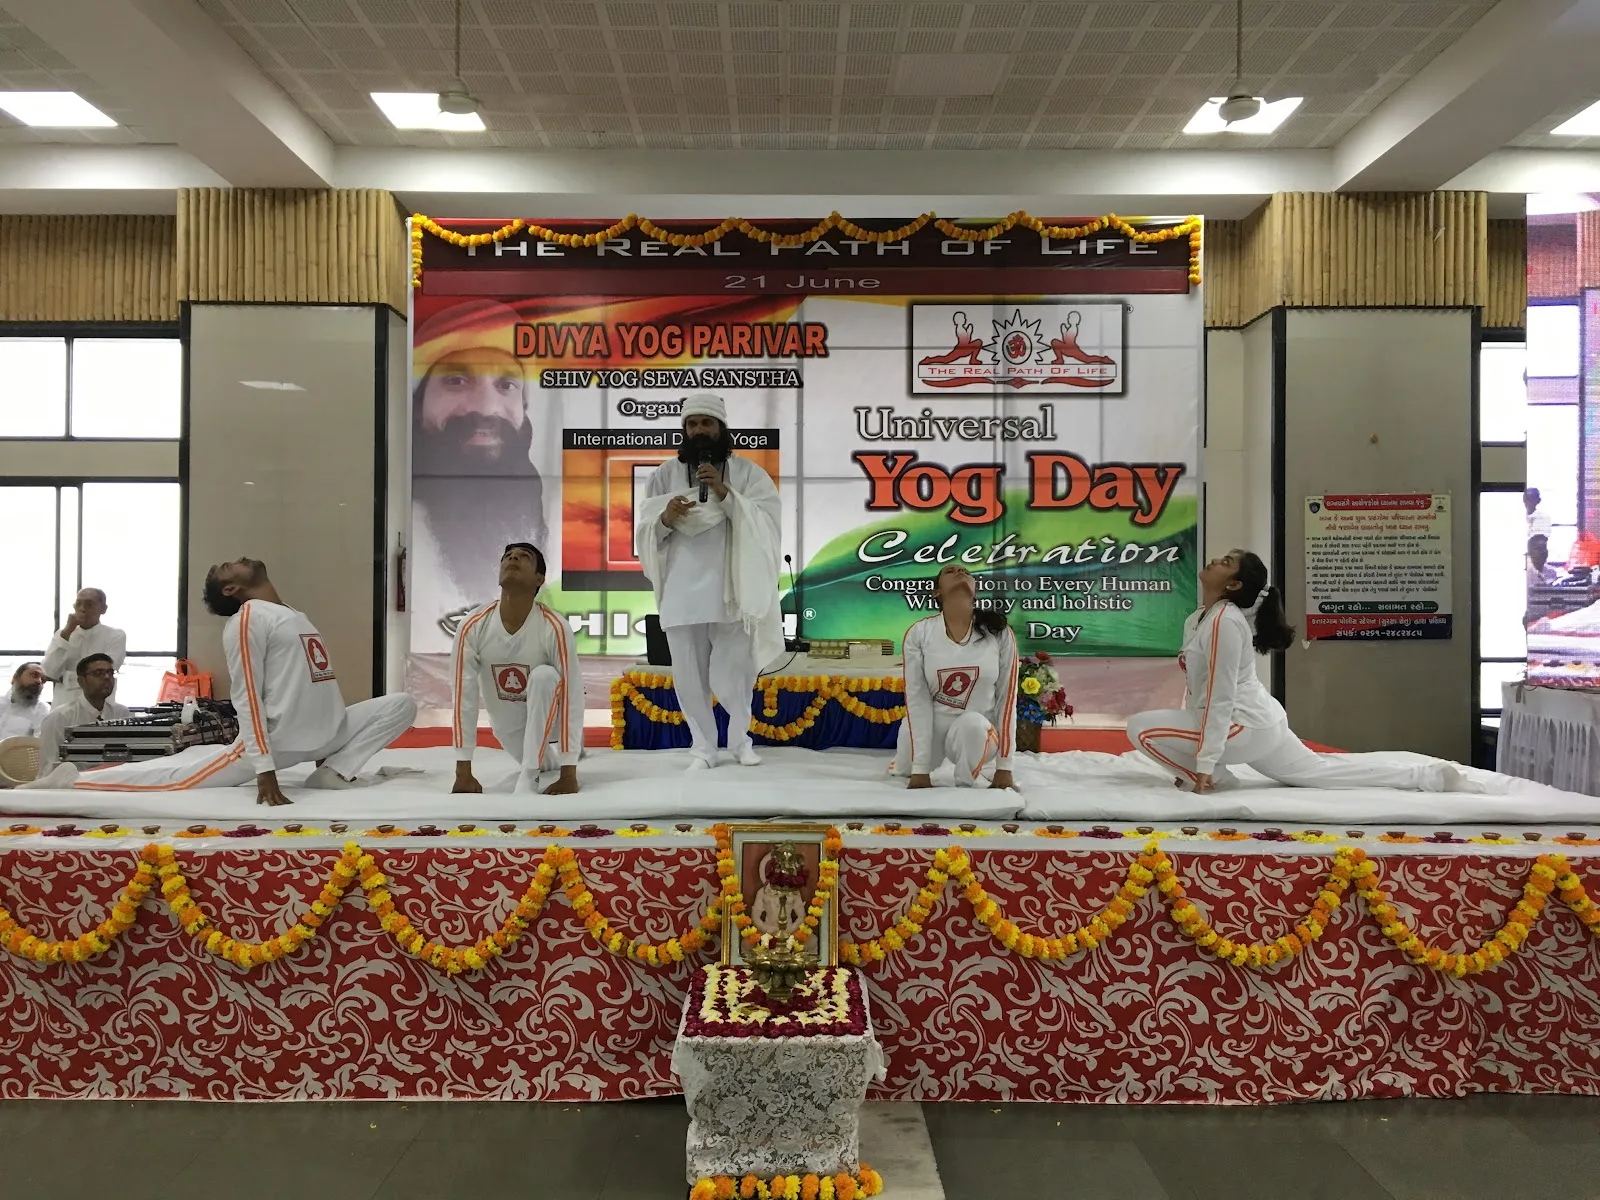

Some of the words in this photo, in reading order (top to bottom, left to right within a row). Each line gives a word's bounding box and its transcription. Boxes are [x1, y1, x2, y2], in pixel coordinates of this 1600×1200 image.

[597, 239, 741, 257] REAL
[941, 239, 1012, 256] OF
[1041, 238, 1158, 255] LIFE
[724, 274, 765, 289] 21
[786, 274, 881, 289] June
[515, 324, 610, 356] DIVYA
[620, 324, 683, 356] YOG
[693, 324, 827, 356] PARIVAR
[542, 370, 591, 388] SHIV
[599, 370, 639, 388] YOG
[643, 370, 698, 388] SEVA
[701, 370, 800, 388] SANSTHA
[927, 367, 956, 375] THE
[963, 367, 1001, 375] REAL
[1007, 367, 1043, 375] PATH
[1077, 367, 1108, 375] LIFE
[854, 405, 1056, 440] Universal
[572, 432, 667, 446] International
[730, 432, 768, 449] Yoga
[853, 453, 1006, 524] Yog
[1028, 453, 1183, 524] Day
[857, 530, 1180, 565] Celebration
[1014, 578, 1033, 591] to
[1039, 576, 1095, 596] Every
[1100, 576, 1171, 591] Human
[1022, 594, 1058, 610] and
[1062, 594, 1133, 610] holistic
[1028, 622, 1082, 642] Day
